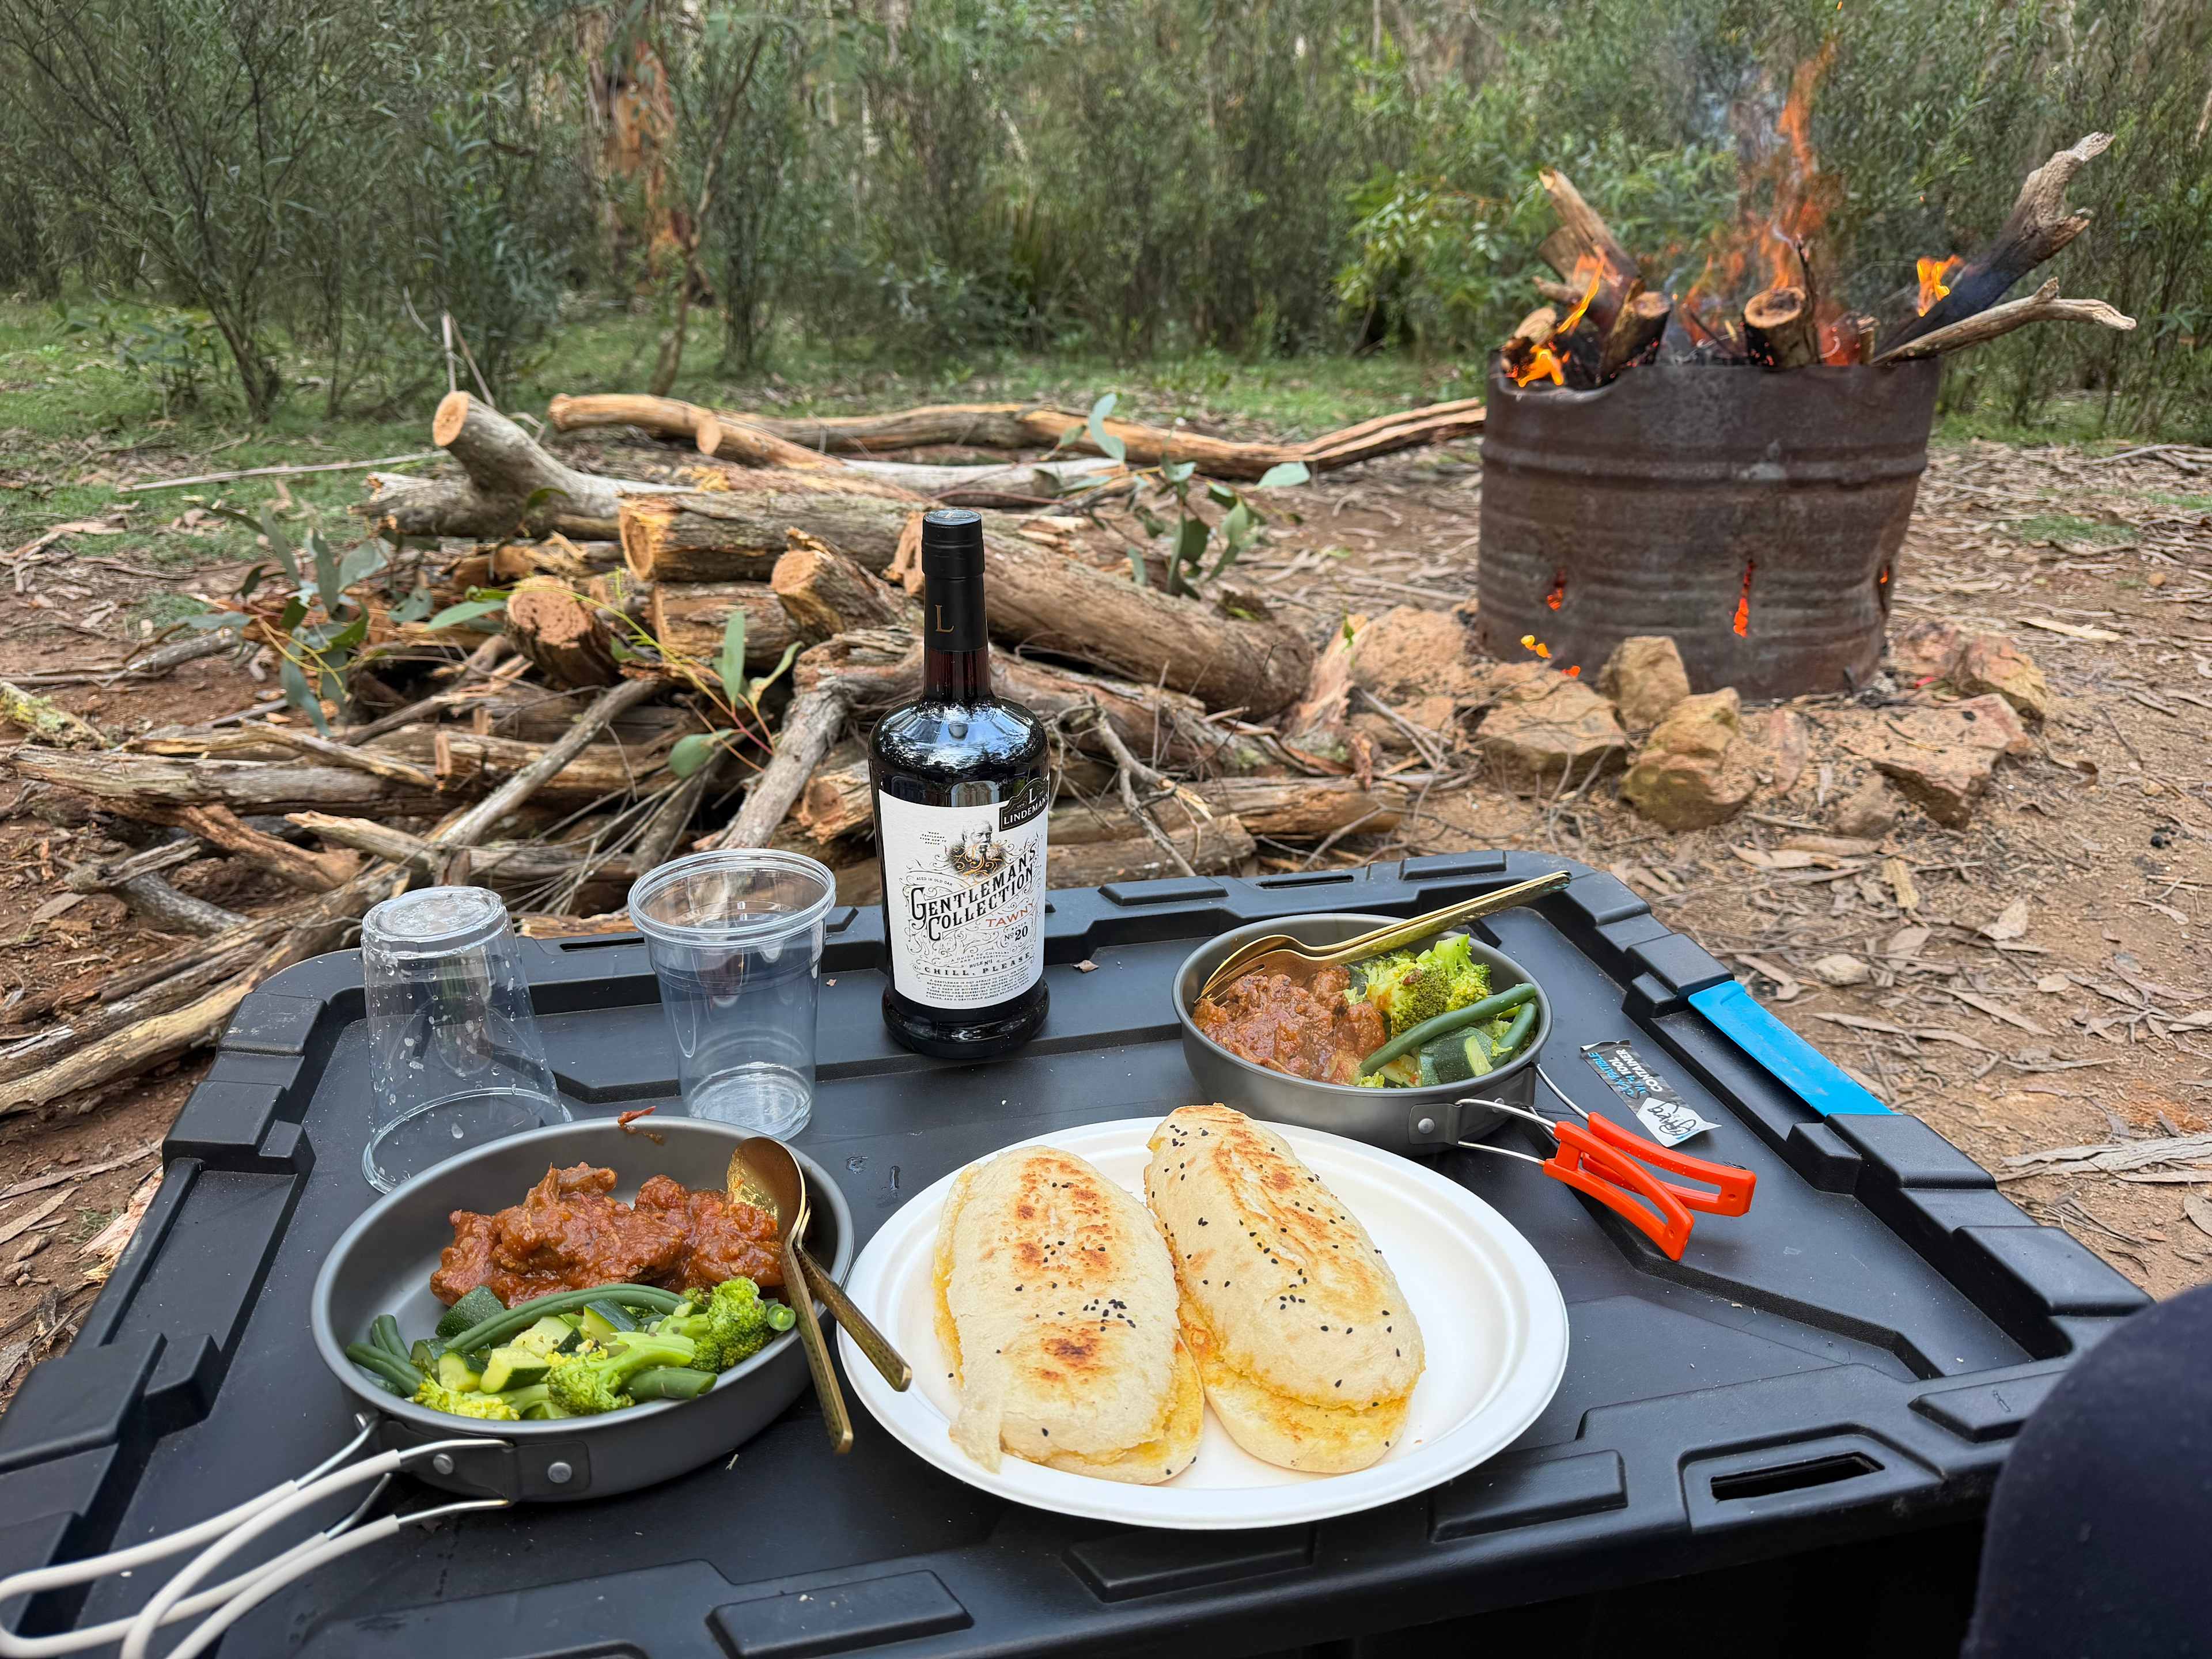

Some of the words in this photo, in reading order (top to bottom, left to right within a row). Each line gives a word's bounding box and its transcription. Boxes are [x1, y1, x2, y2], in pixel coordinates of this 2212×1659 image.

[935, 604, 955, 633] L
[1028, 787, 1037, 804] L
[928, 864, 1033, 941] COLLECTION
[986, 903, 1033, 927] TAWNY
[1015, 926, 1028, 941] 20
[982, 952, 1030, 974] PLEASE
[1615, 1048, 1663, 1092] CONTAINER
